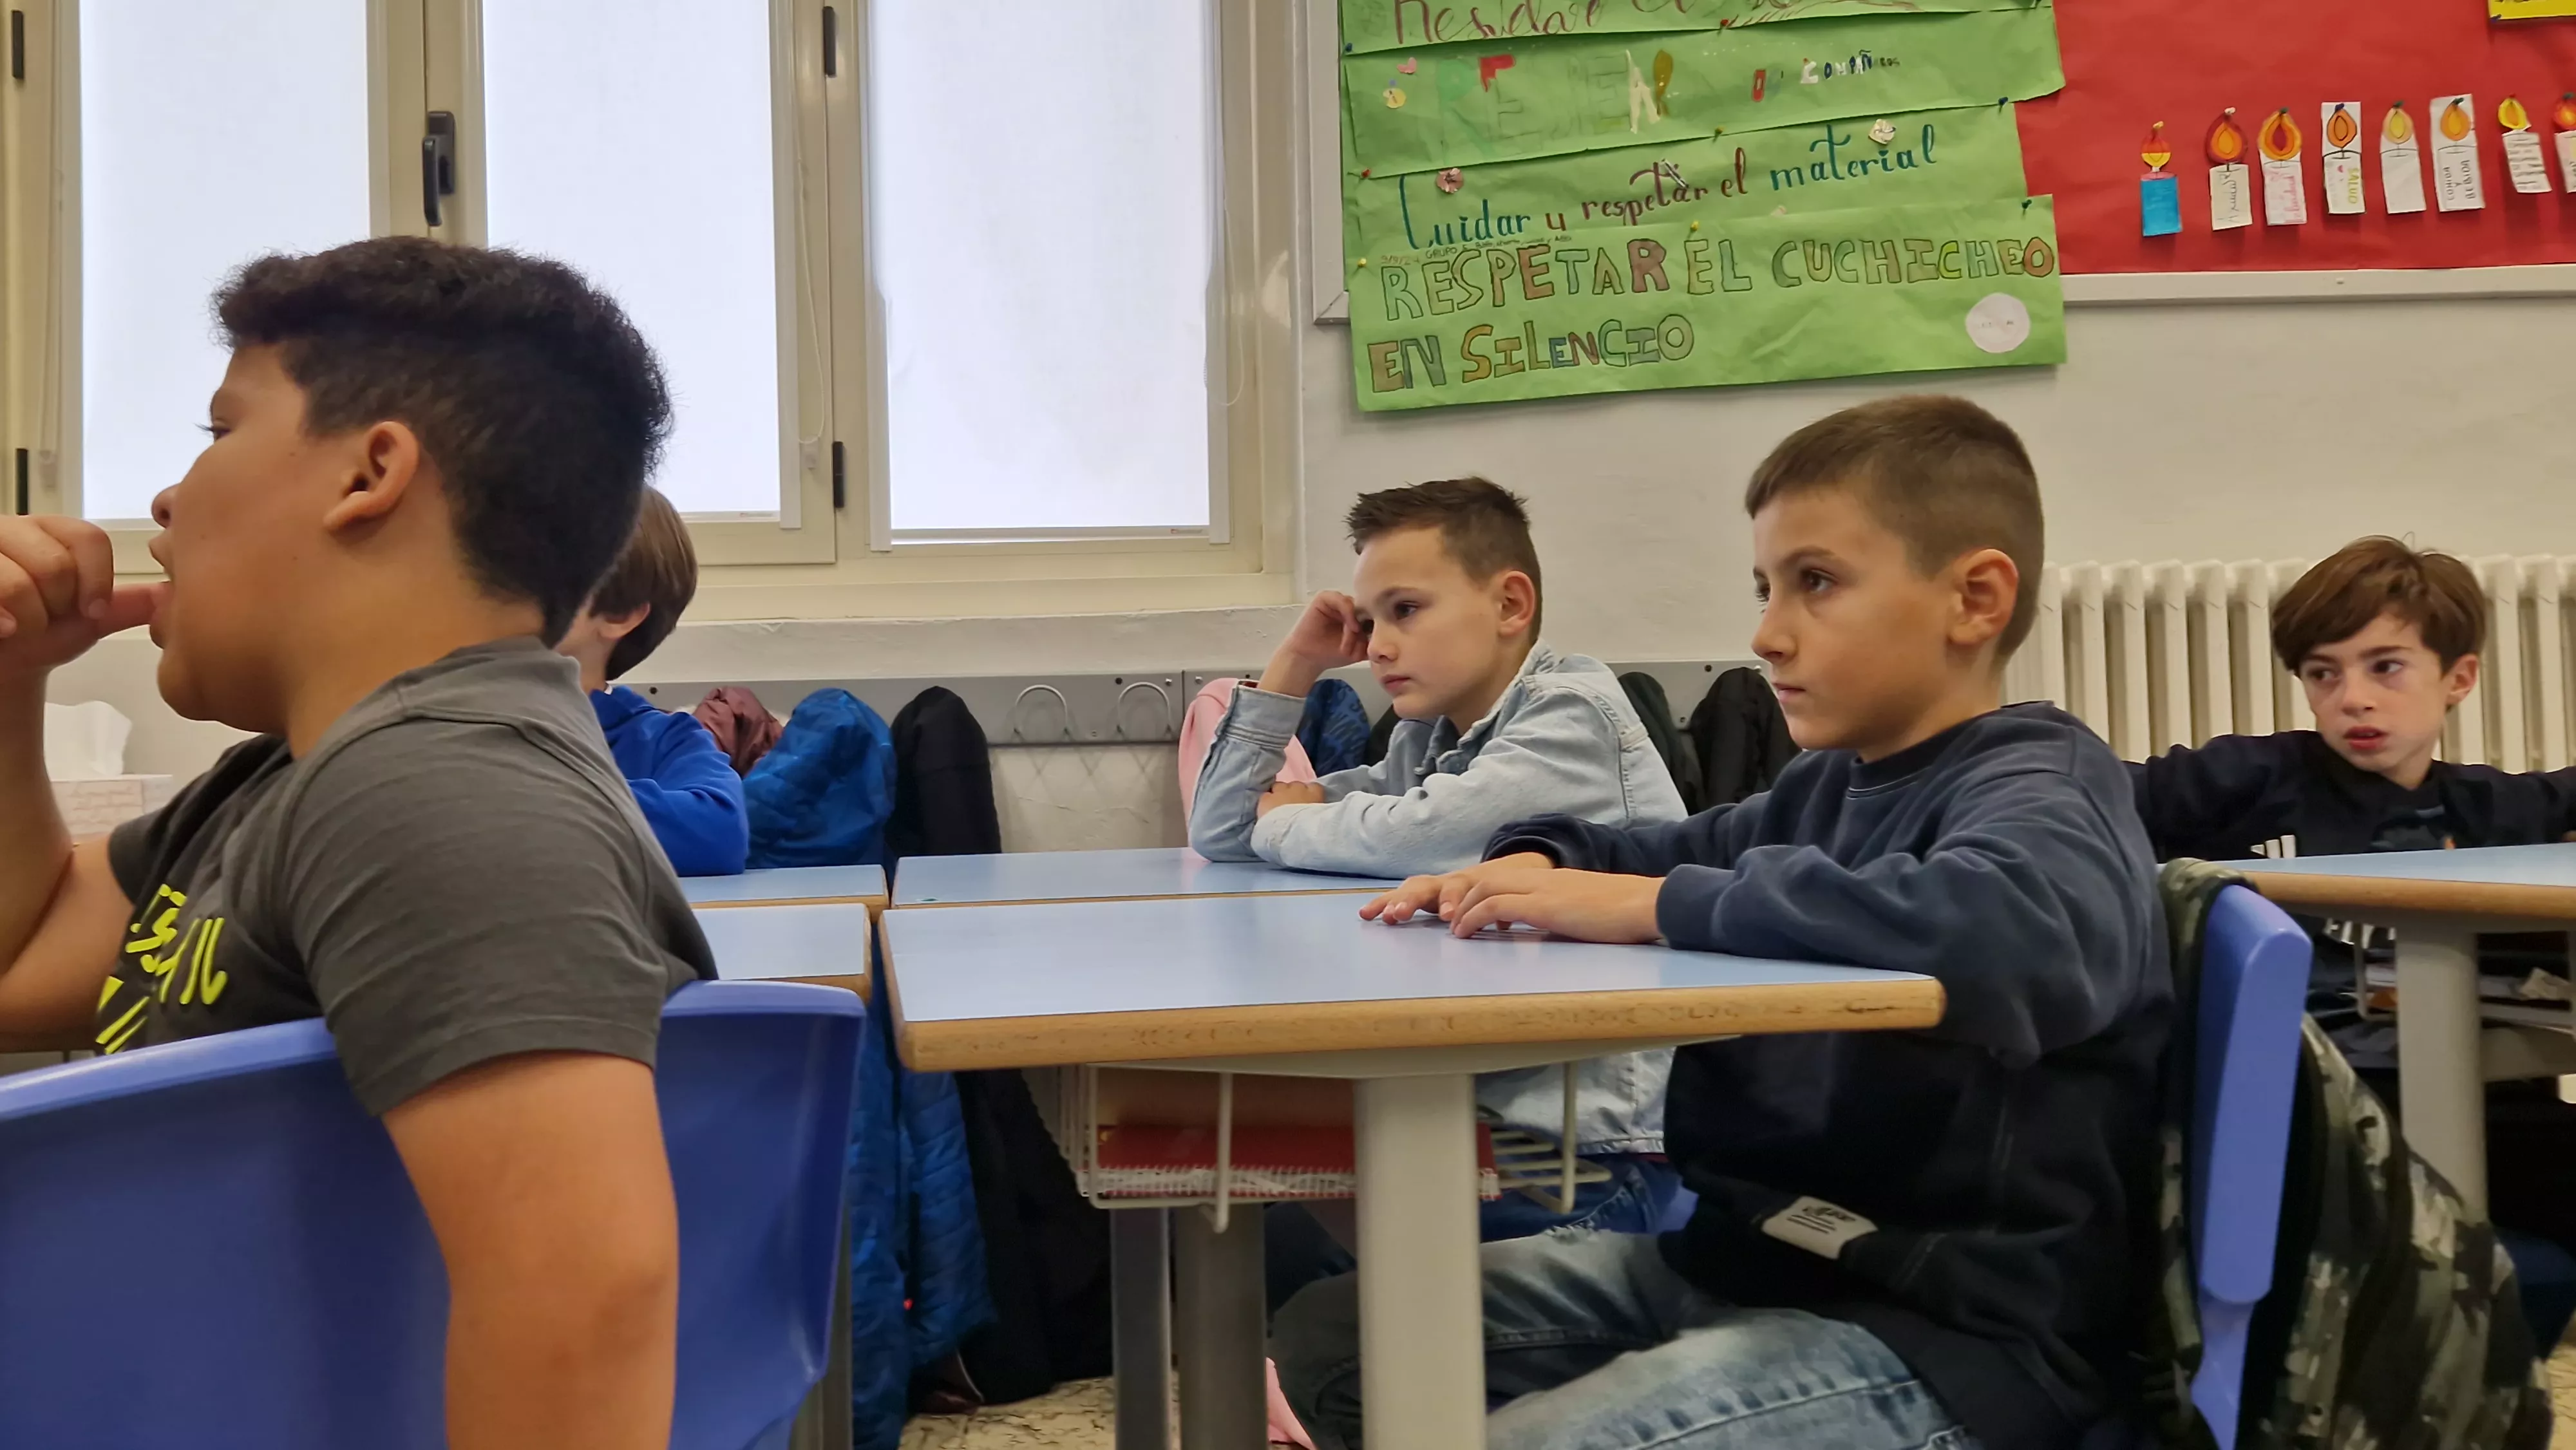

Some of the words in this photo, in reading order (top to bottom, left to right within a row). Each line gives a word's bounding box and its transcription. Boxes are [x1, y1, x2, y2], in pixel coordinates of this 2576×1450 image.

[1398, 175, 1531, 250] Cuidar
[1581, 162, 1709, 225] respetar
[1720, 147, 1748, 198] el
[1769, 124, 1937, 191] material
[1380, 238, 1671, 321] RESPETAR
[1684, 238, 1753, 296] EL
[1771, 236, 2055, 288] CUCHICHEO
[1368, 334, 1447, 393] EN
[1460, 314, 1695, 384] SILENCIO
